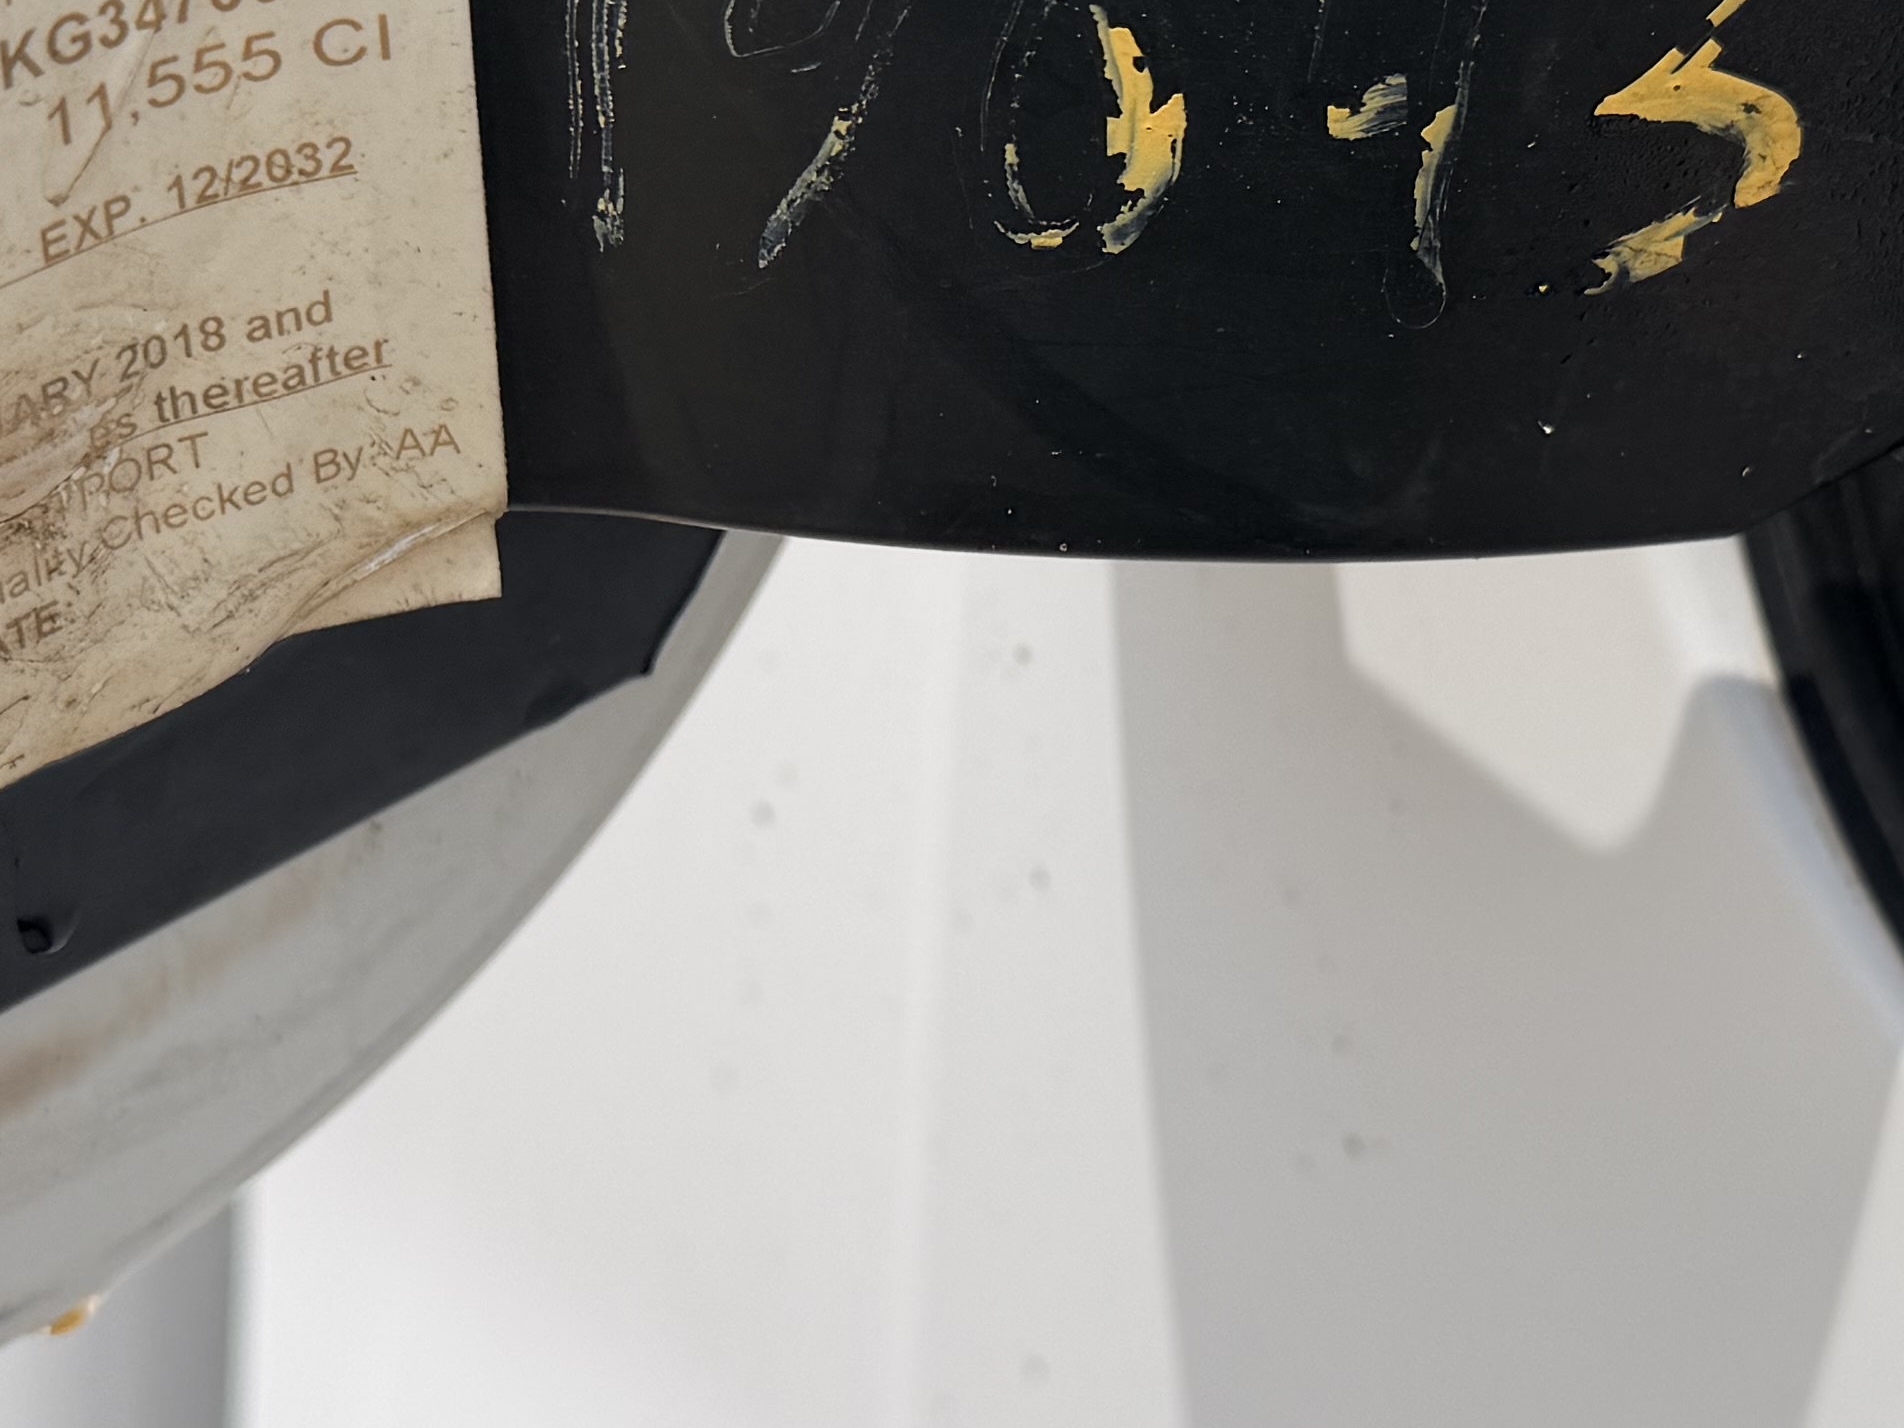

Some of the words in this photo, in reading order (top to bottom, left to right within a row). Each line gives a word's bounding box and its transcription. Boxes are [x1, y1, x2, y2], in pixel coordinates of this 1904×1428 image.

[47, 31, 283, 145] 11,555
[312, 13, 391, 67] CI
[40, 194, 146, 264] EXP.
[166, 135, 356, 210] 12/2032
[116, 316, 226, 383] 2018
[246, 289, 334, 343] and
[153, 338, 389, 423] thereafter
[101, 462, 294, 551] Checked
[396, 424, 460, 461] AA
